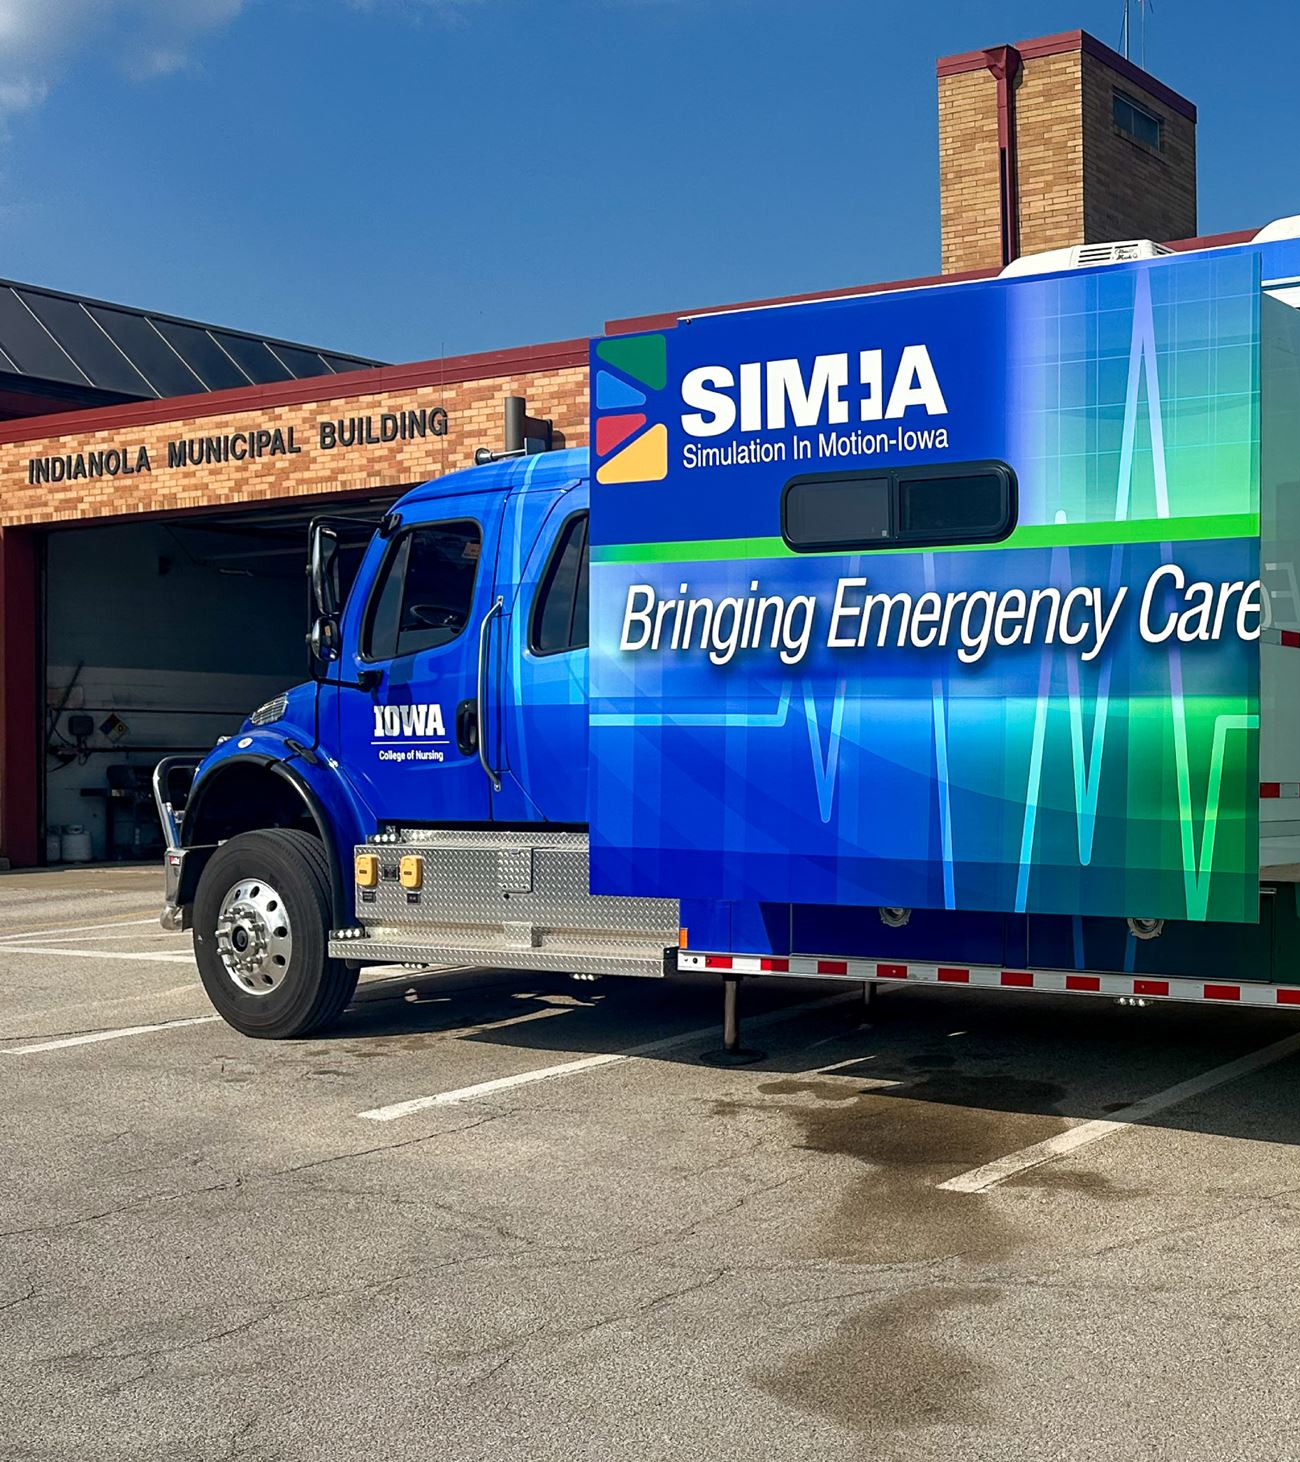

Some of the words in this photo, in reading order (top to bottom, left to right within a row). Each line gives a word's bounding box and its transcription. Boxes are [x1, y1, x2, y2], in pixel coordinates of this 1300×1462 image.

[28, 446, 152, 485] INDIANOLA
[167, 426, 302, 469] MUNICIPAL
[319, 407, 449, 451] BUILDING
[682, 440, 786, 469] Simulation
[793, 435, 811, 460] In
[818, 427, 949, 458] Motion-Iowa
[618, 580, 817, 666] Bringing
[826, 577, 1128, 664] Emergency
[1139, 564, 1261, 643] Care
[373, 703, 446, 737] IOWA
[378, 750, 406, 763] College
[406, 749, 415, 761] of
[415, 749, 444, 762] Nursing
